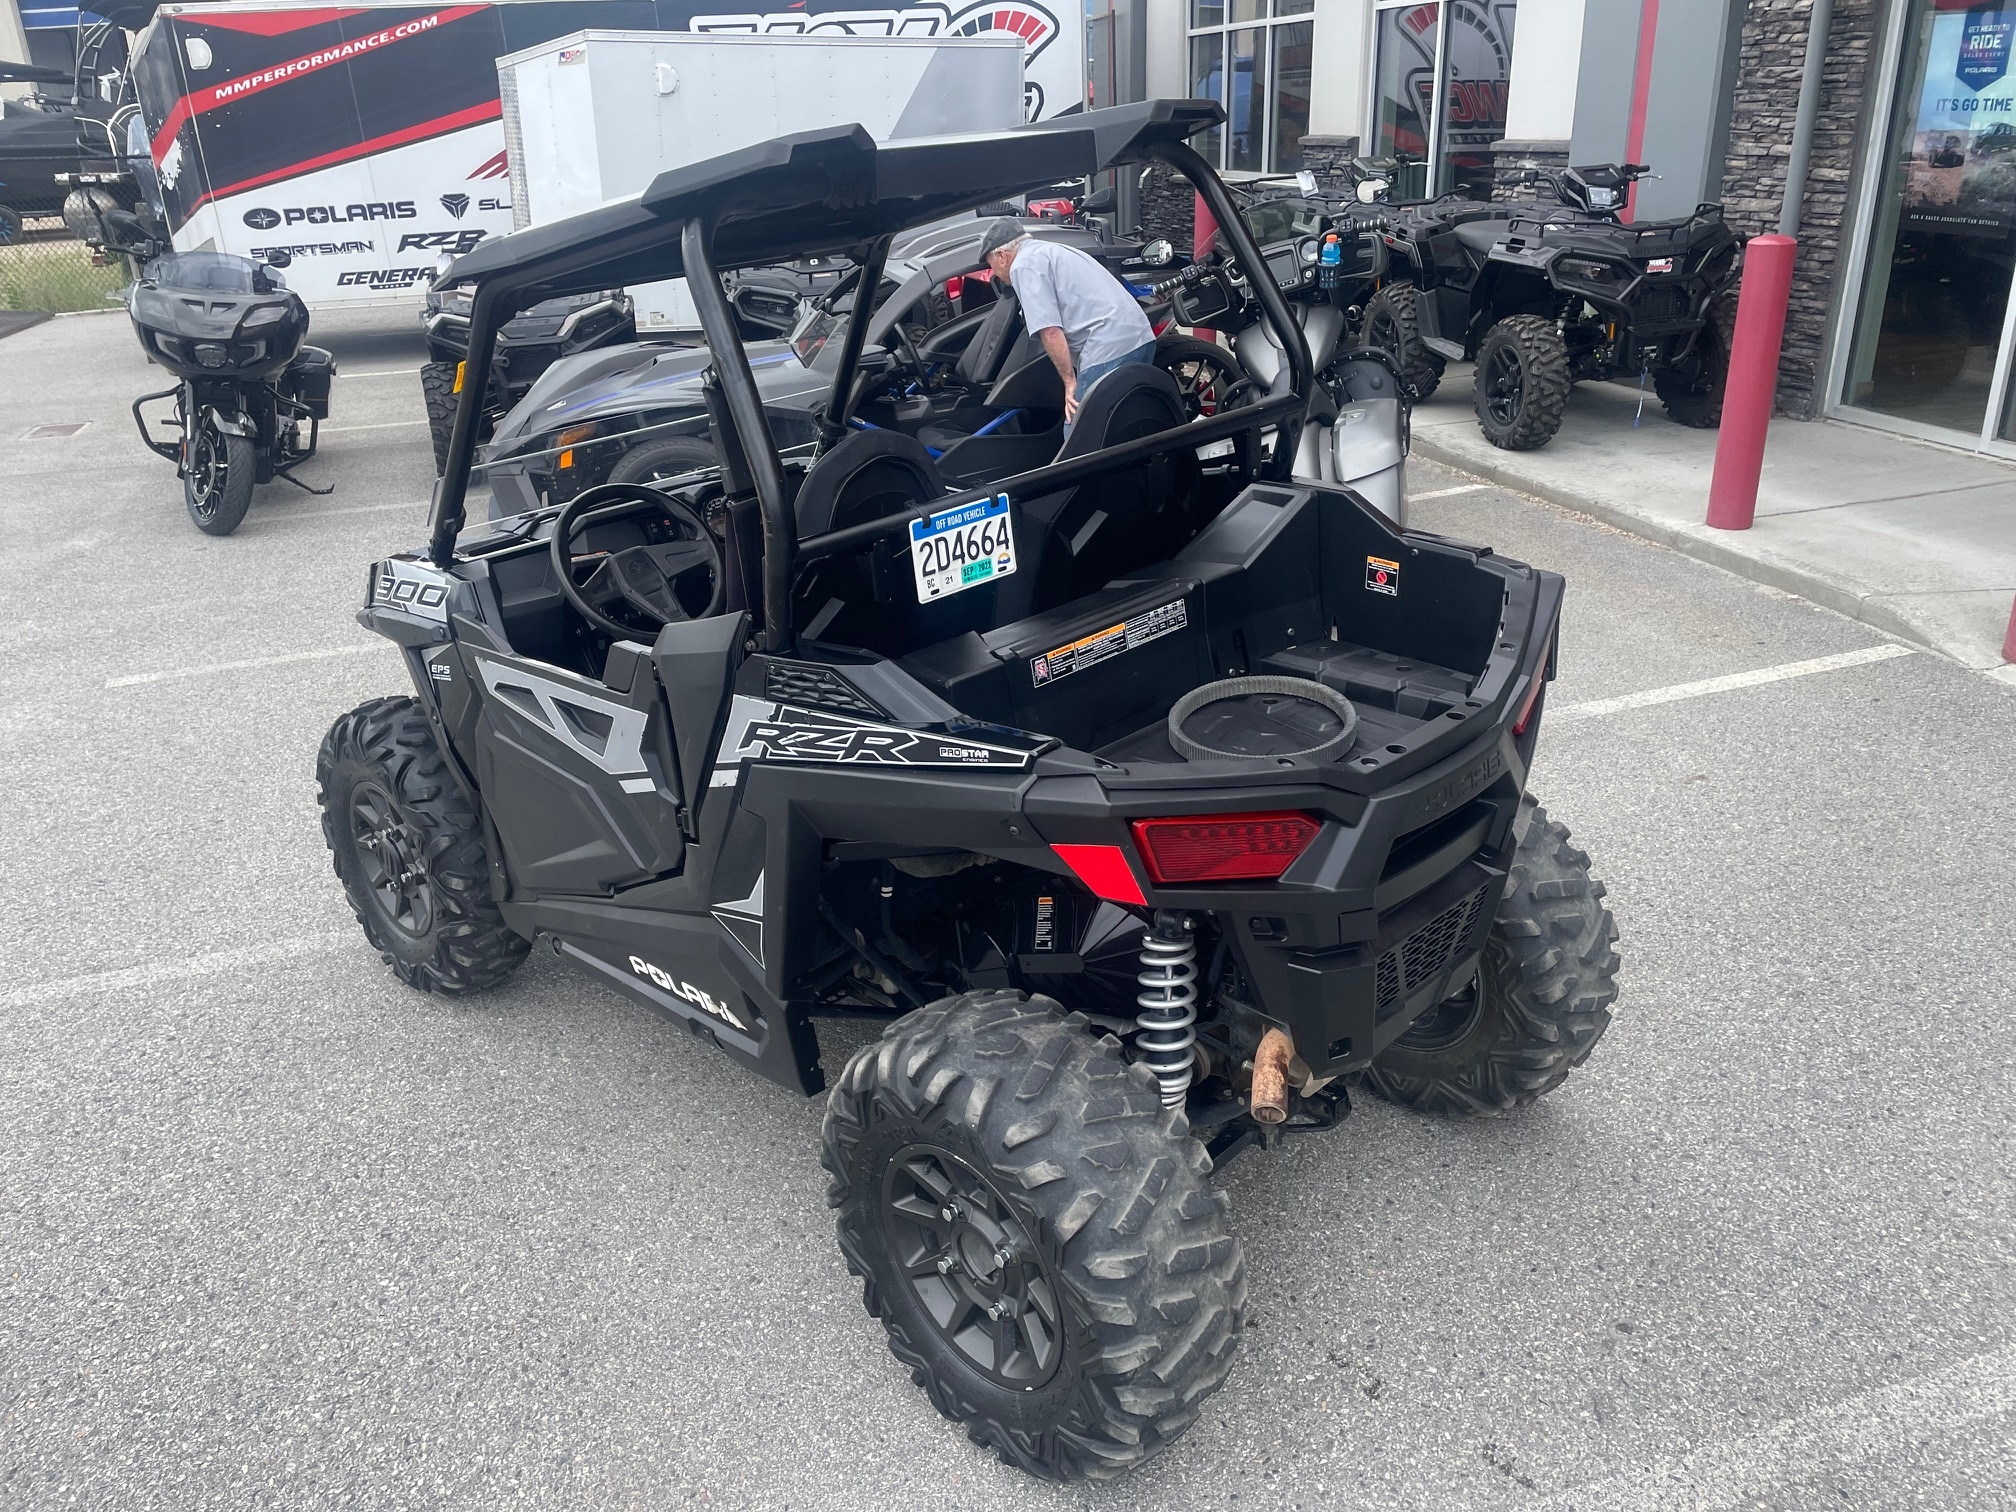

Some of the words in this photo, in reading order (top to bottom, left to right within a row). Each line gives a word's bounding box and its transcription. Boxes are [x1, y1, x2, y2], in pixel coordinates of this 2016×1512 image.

[1981, 24, 2001, 32] READY
[2002, 23, 2011, 31] TO
[1969, 34, 2004, 50] RIDE
[215, 15, 438, 99] MMPERFORMANCE.COM
[1964, 66, 1998, 74] POLARIS
[1936, 98, 1960, 112] IT'S
[1962, 98, 1980, 112] GO
[1982, 97, 2014, 112] TIME
[283, 200, 417, 226] POLARIS
[397, 229, 488, 254] RZR
[337, 267, 432, 287] GENERA
[936, 518, 947, 530] OFF
[947, 515, 963, 527] ROAD
[963, 506, 986, 522] VEHICLE
[919, 516, 1010, 578] 2D4664
[963, 566, 974, 577] SEP
[977, 560, 992, 572] 2022
[927, 578, 936, 589] BC
[945, 575, 954, 585] 21
[431, 664, 451, 675] EPS
[735, 719, 920, 764] RZR
